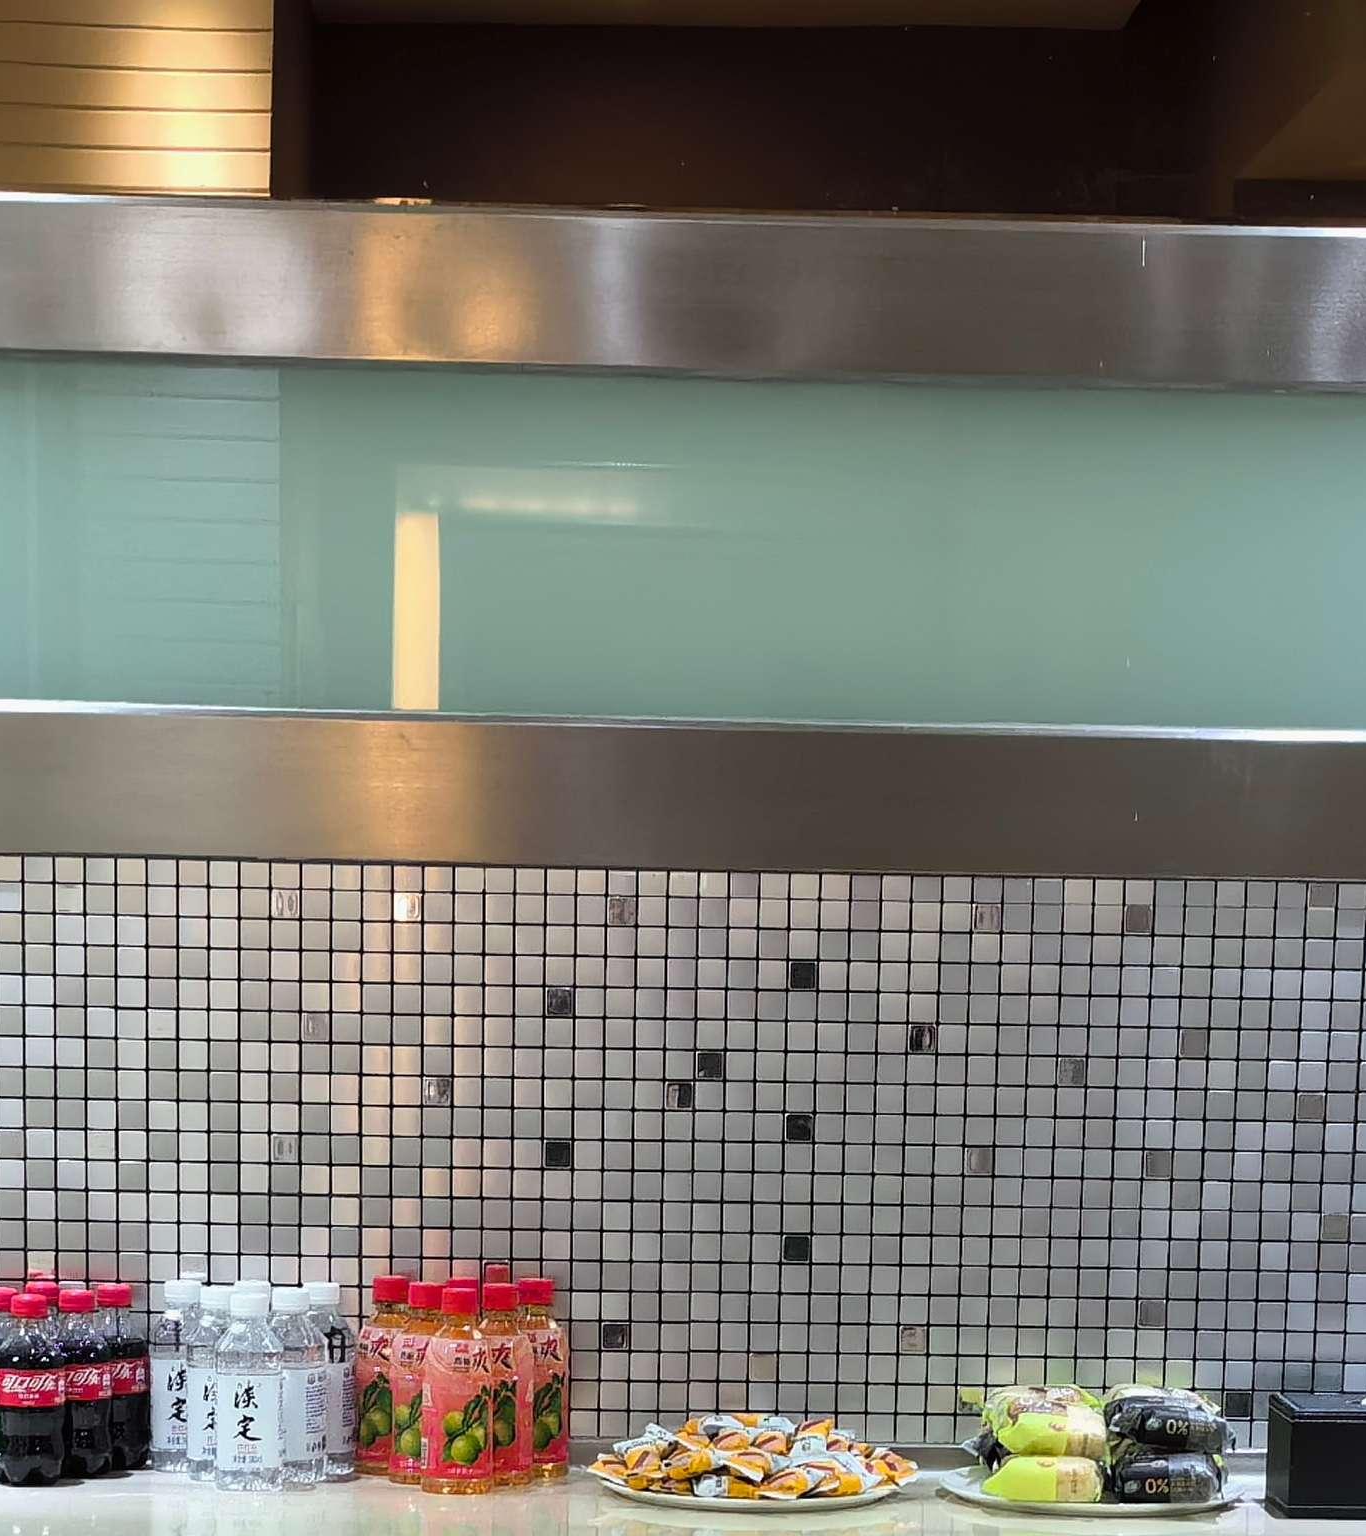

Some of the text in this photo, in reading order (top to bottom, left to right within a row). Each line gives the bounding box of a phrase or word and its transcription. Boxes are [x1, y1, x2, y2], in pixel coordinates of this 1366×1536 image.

[0, 1373, 58, 1394] 可口可乐
[234, 1379, 263, 1442] 淡定
[1165, 1418, 1189, 1436] 0%
[1145, 1477, 1170, 1494] 0%
